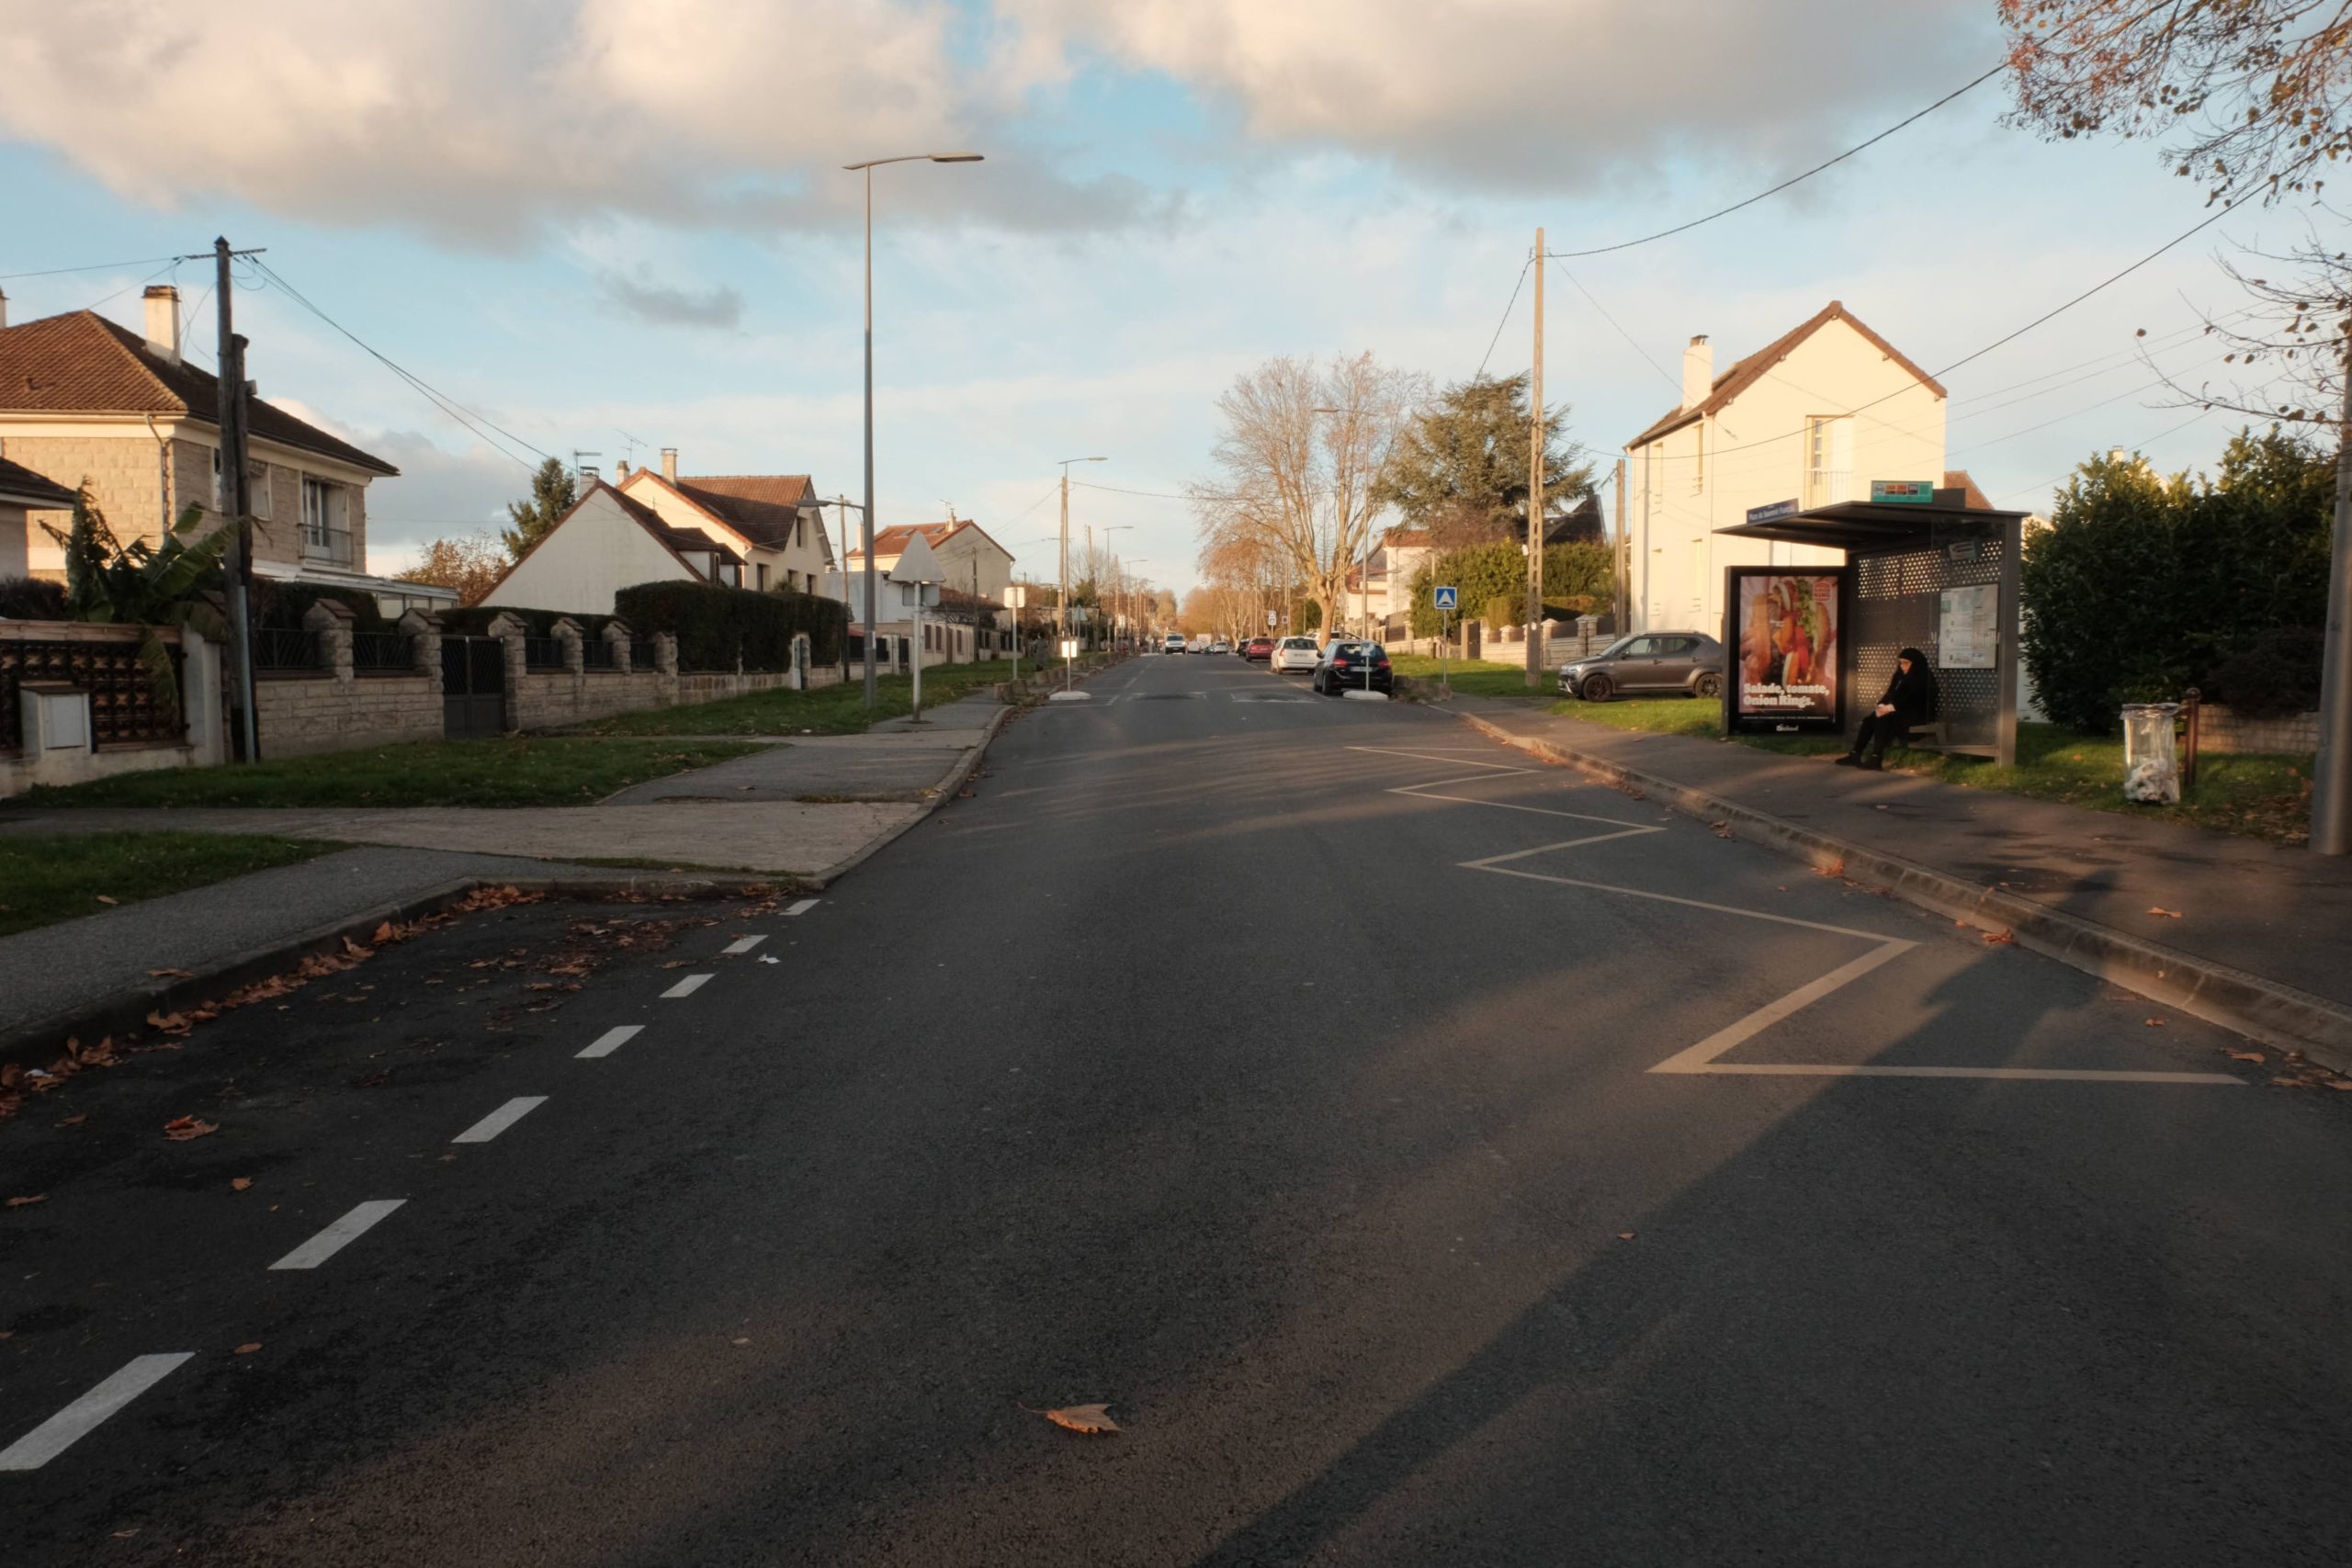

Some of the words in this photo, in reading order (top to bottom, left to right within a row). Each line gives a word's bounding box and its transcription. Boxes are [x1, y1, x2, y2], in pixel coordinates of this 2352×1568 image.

[1744, 682, 1785, 695] Salade,
[1786, 684, 1829, 695] tomate,
[1744, 694, 1778, 705] Onion
[1779, 694, 1815, 708] Rings.
